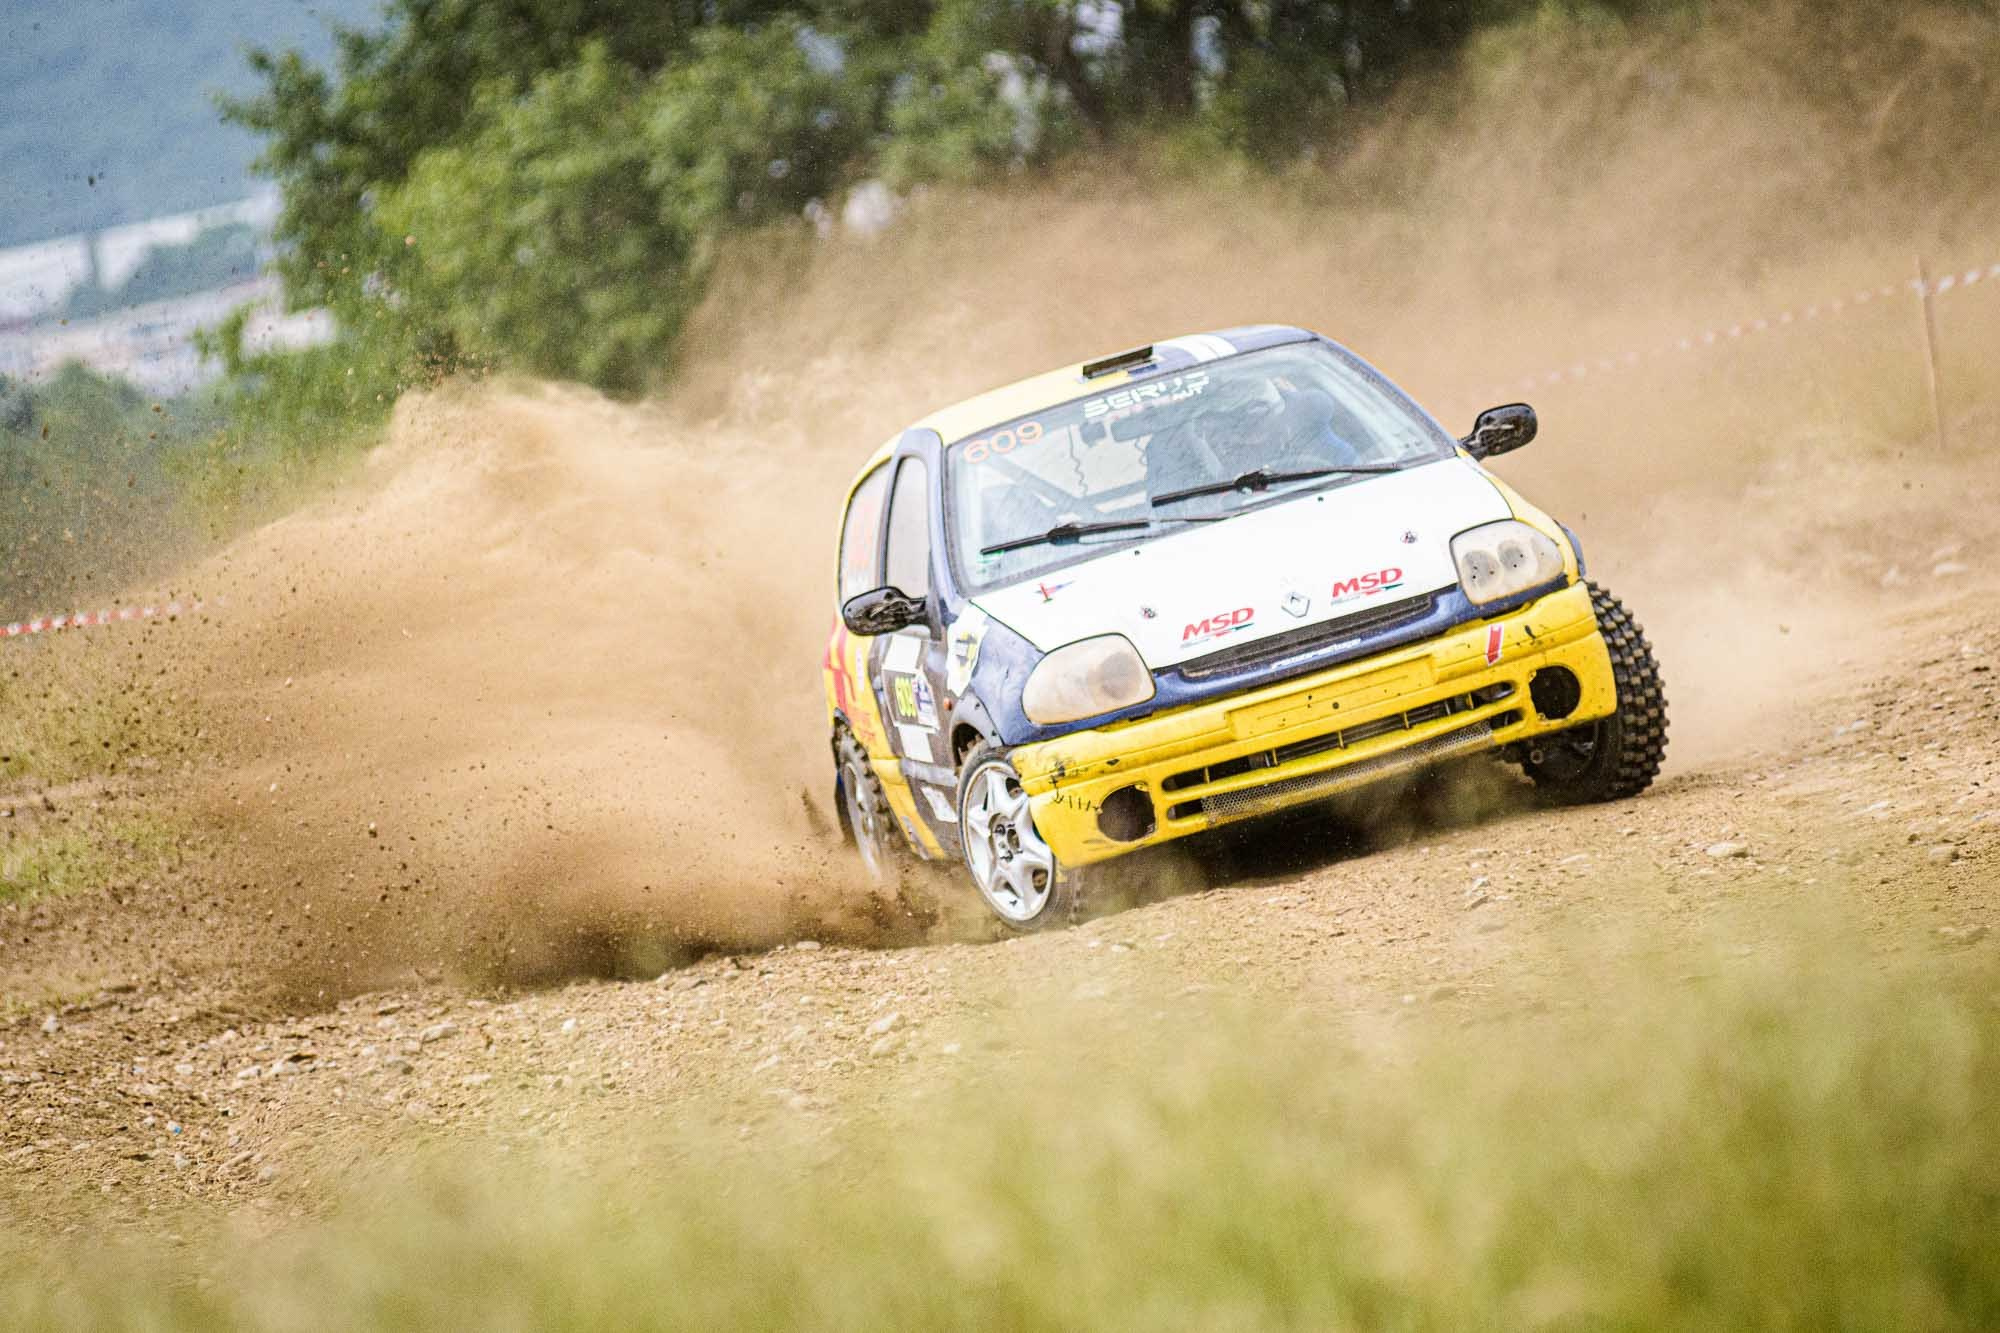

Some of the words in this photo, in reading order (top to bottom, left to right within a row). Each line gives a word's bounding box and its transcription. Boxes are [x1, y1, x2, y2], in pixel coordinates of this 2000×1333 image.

[963, 421, 1043, 464] 609
[1332, 567, 1403, 598] MSD
[1182, 607, 1255, 641] MSD
